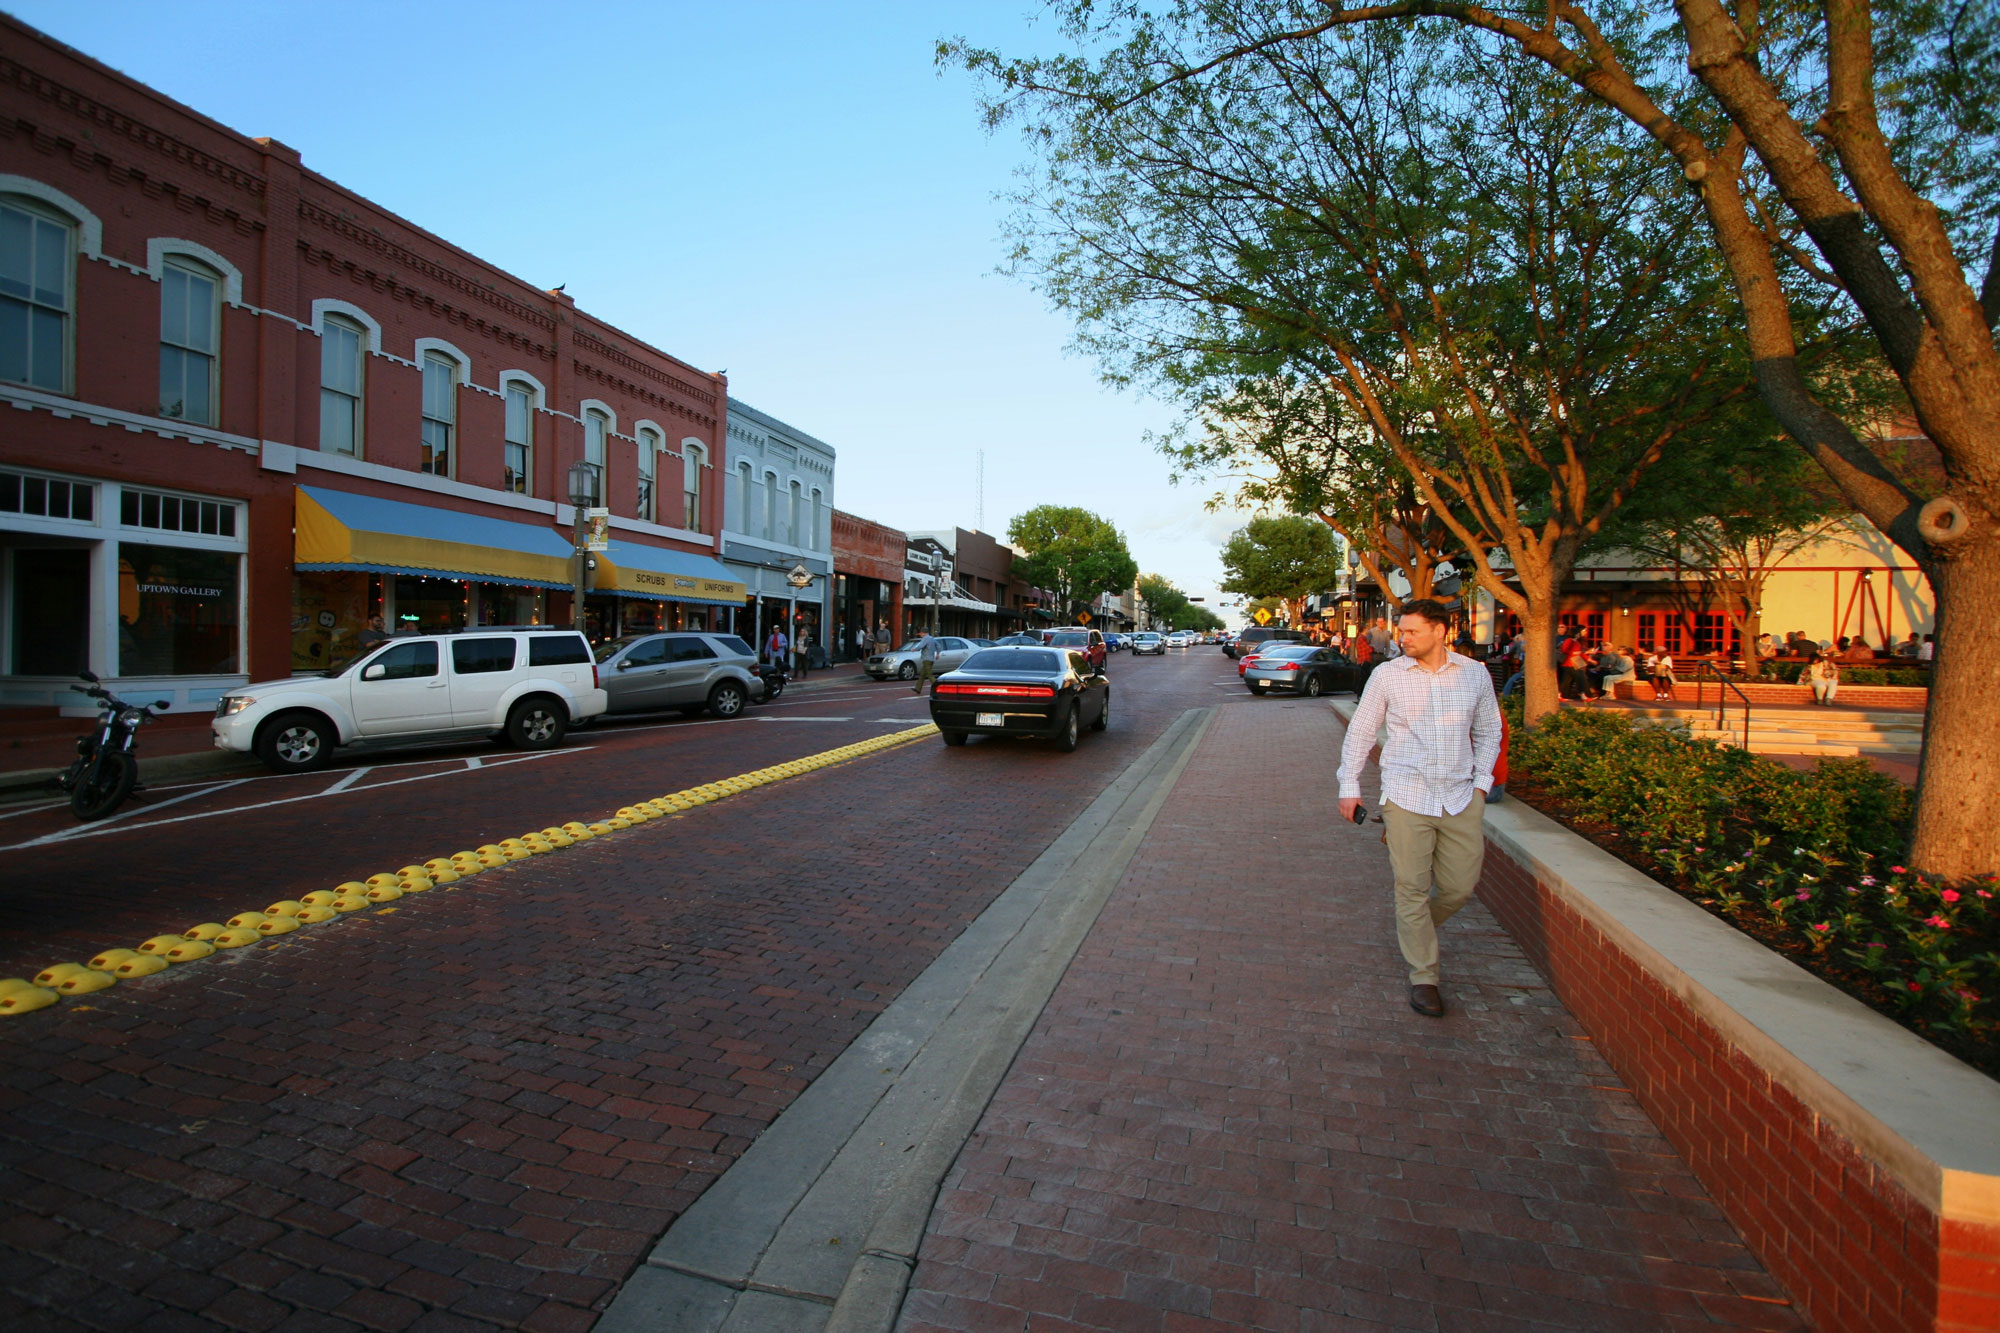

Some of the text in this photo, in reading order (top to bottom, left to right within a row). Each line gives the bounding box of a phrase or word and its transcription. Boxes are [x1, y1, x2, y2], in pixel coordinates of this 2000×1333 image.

[136, 584, 222, 597] UPTOWN GALLERY
[636, 573, 666, 586] SCRUBS
[704, 583, 734, 593] UNIFORMS
